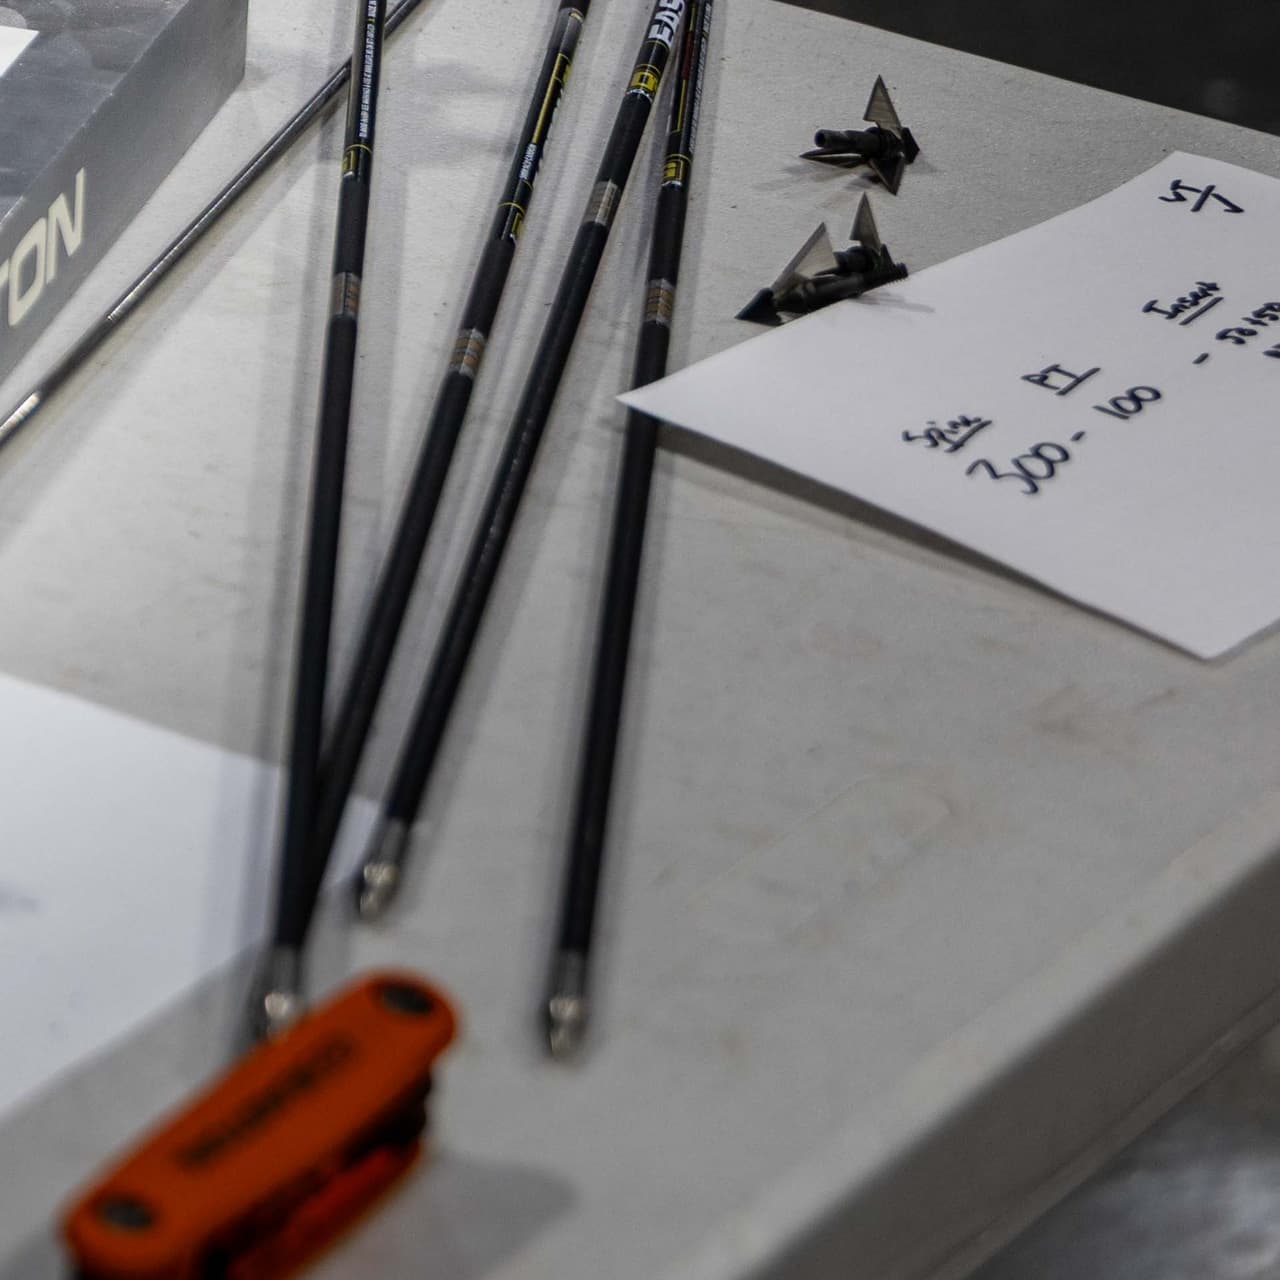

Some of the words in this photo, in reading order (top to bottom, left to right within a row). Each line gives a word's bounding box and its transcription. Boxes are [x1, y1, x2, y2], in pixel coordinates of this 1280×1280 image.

[1142, 282, 1220, 320] Insert
[967, 442, 1070, 495] 300
[1093, 385, 1162, 420] 100
